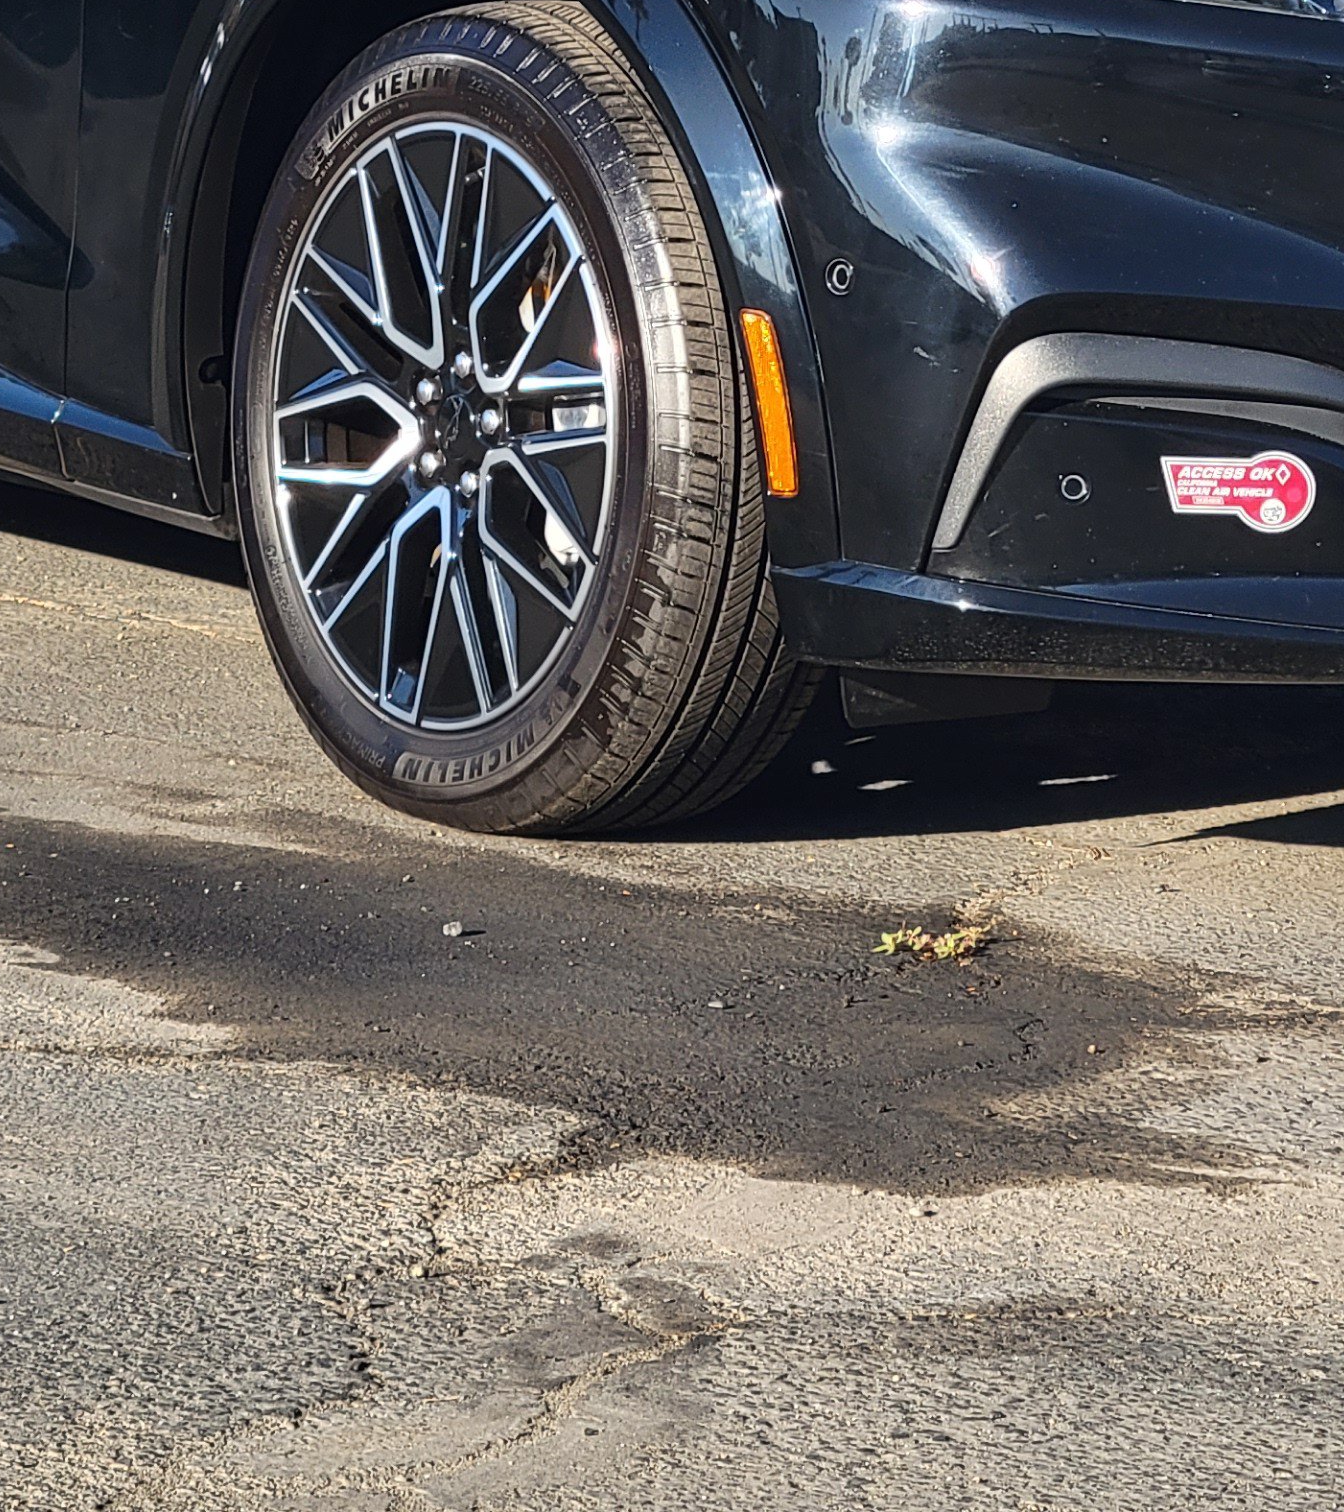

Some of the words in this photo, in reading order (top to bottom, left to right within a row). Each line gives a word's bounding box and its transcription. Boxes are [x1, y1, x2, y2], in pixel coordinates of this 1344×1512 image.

[326, 66, 452, 143] MICHELIN
[1177, 466, 1246, 481] ACCESS
[1249, 467, 1277, 481] OK
[1177, 486, 1211, 496] CLEAN
[1212, 487, 1231, 496] AIR
[1233, 487, 1275, 498] VEHICLE
[400, 723, 536, 783] MICHELIN
